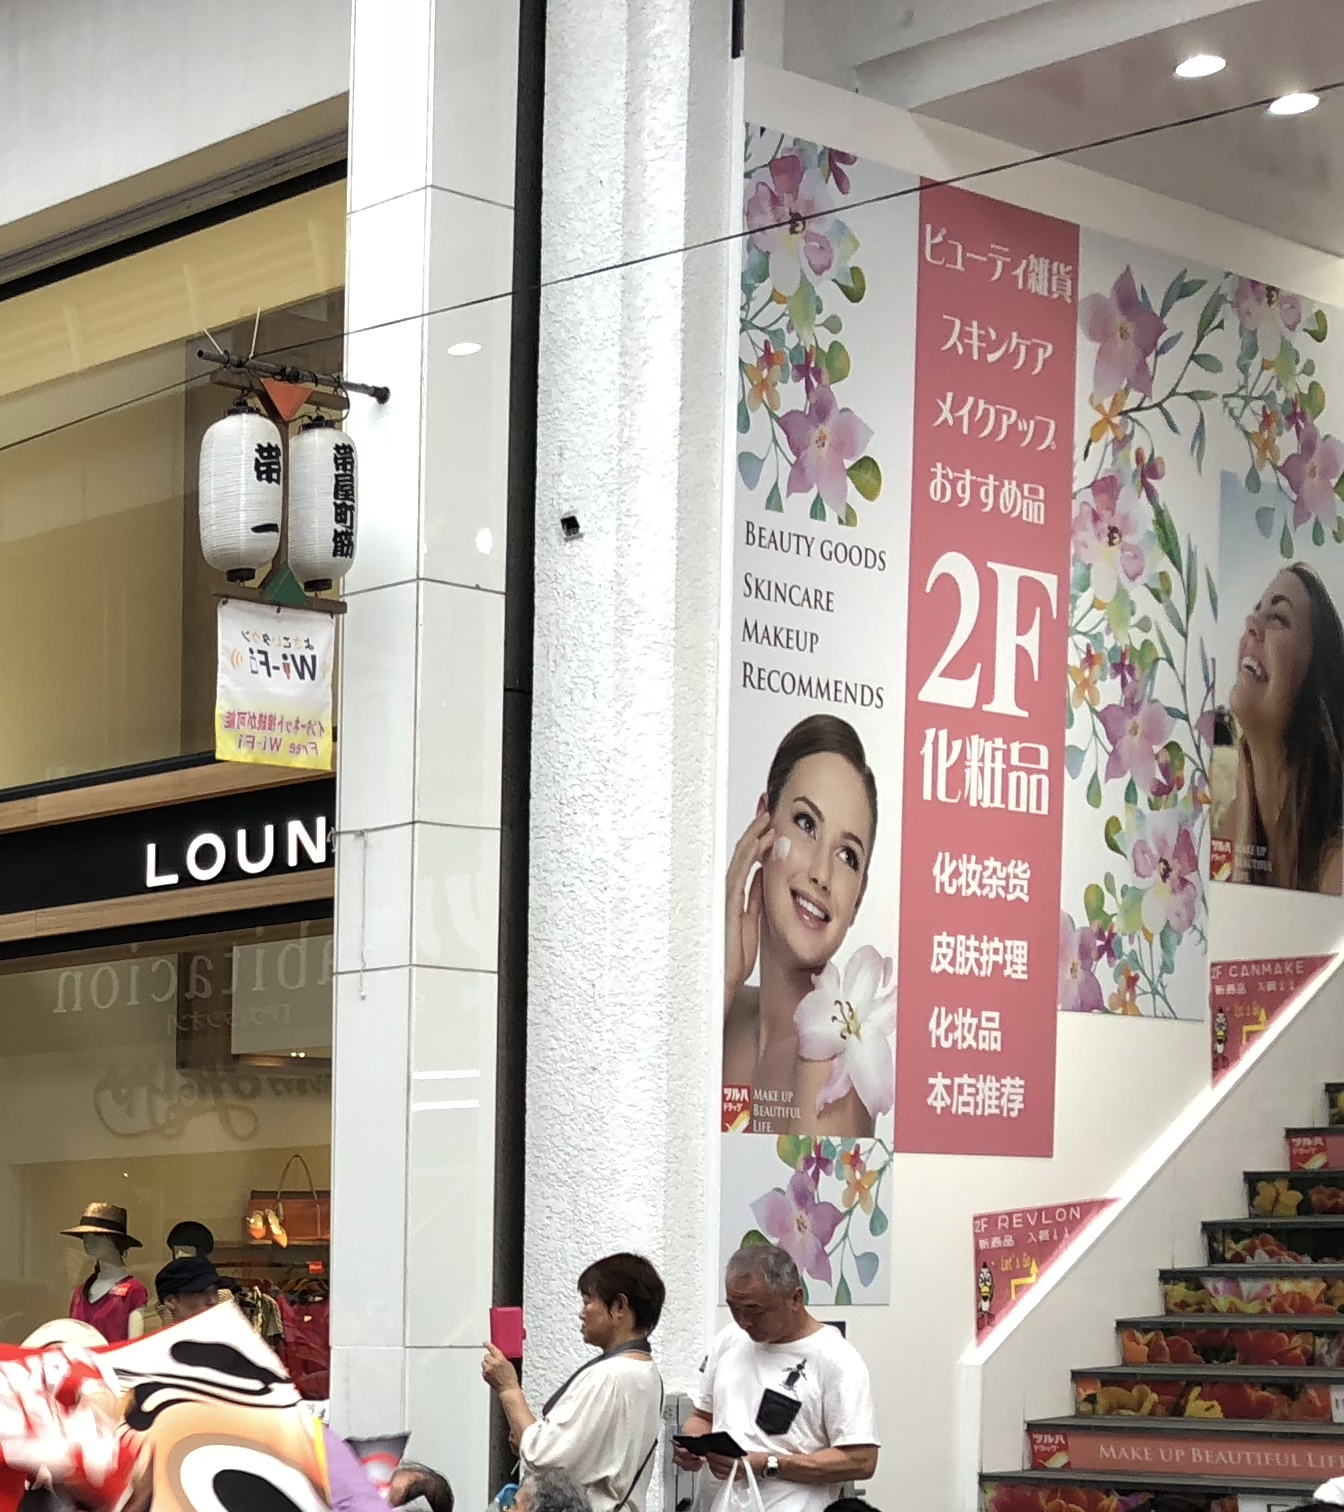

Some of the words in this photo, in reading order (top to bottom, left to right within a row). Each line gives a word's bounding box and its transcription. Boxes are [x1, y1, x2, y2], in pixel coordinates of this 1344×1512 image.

[924, 222, 1073, 304] ビューティ雑貨
[941, 313, 1053, 376] スキンケア
[932, 391, 1057, 451] メイクアップ
[251, 442, 281, 533] 帯一
[332, 443, 355, 559] 帯屋町筋
[930, 462, 1045, 525] おすすめ品
[917, 551, 1058, 718] 2F
[920, 727, 1050, 815] 化粧品
[144, 816, 327, 887] LOUN
[932, 852, 1031, 903] 化妆杂货
[930, 931, 1029, 980] 皮肤护理
[1229, 961, 1304, 978] CANMAKE
[929, 1006, 1002, 1051] 化妆品
[926, 1072, 1025, 1118] 本店推荐
[974, 1218, 989, 1232] 2F
[997, 1205, 1081, 1230] REVLON
